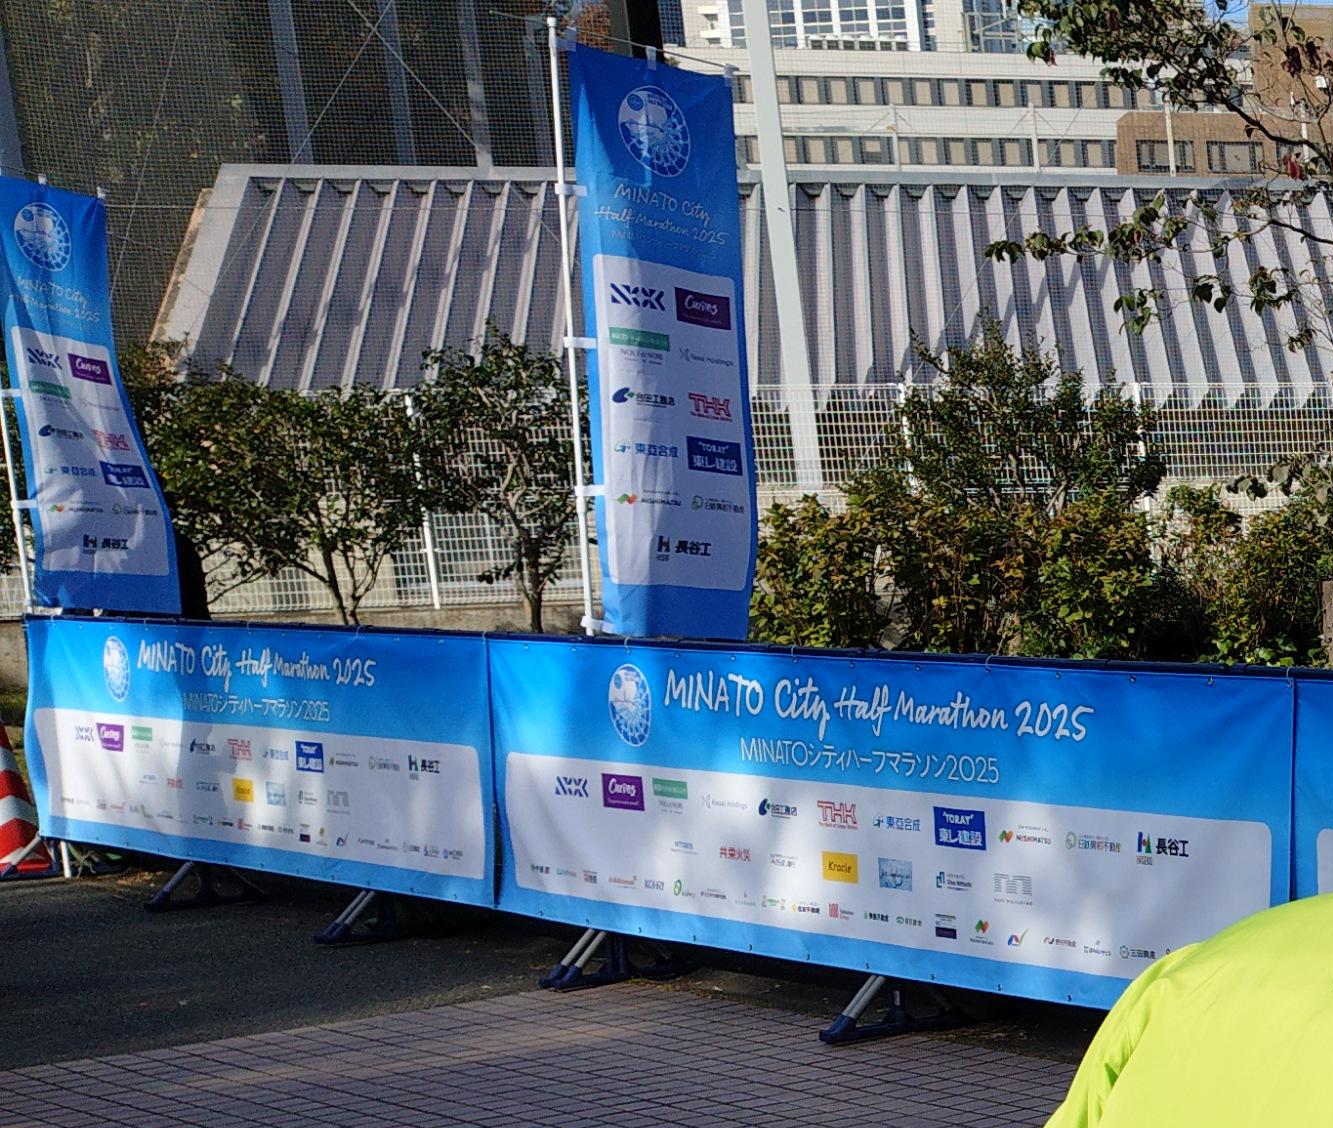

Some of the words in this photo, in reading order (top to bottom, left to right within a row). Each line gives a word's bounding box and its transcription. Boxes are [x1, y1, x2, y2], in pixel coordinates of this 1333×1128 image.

[614, 183, 677, 211] MINATO
[682, 200, 710, 226] City
[593, 206, 635, 229] Half
[636, 214, 689, 236] Marathon
[693, 229, 729, 245] 2025
[688, 392, 731, 418] THK
[693, 454, 738, 472] 東レ建設
[675, 540, 711, 556] 長谷工
[137, 639, 195, 676] MINATO
[200, 644, 232, 692] City
[235, 647, 273, 688] Half
[273, 652, 330, 680] Marathon
[333, 657, 377, 686] 2025
[664, 668, 763, 717] MINATO
[774, 677, 830, 741] City
[834, 684, 891, 736] Half
[894, 690, 1008, 730] Marathon
[1014, 700, 1094, 741] 2025
[740, 737, 999, 783] MINATOシティハーフマラソン2025
[608, 777, 636, 797] Curves
[817, 800, 857, 824] THK
[886, 816, 920, 831] 東亞合成
[939, 828, 983, 846] 東レ建設
[1016, 834, 1051, 845] NISHIMATSU
[1156, 838, 1189, 857] 長谷工
[828, 861, 852, 873] Kracie
